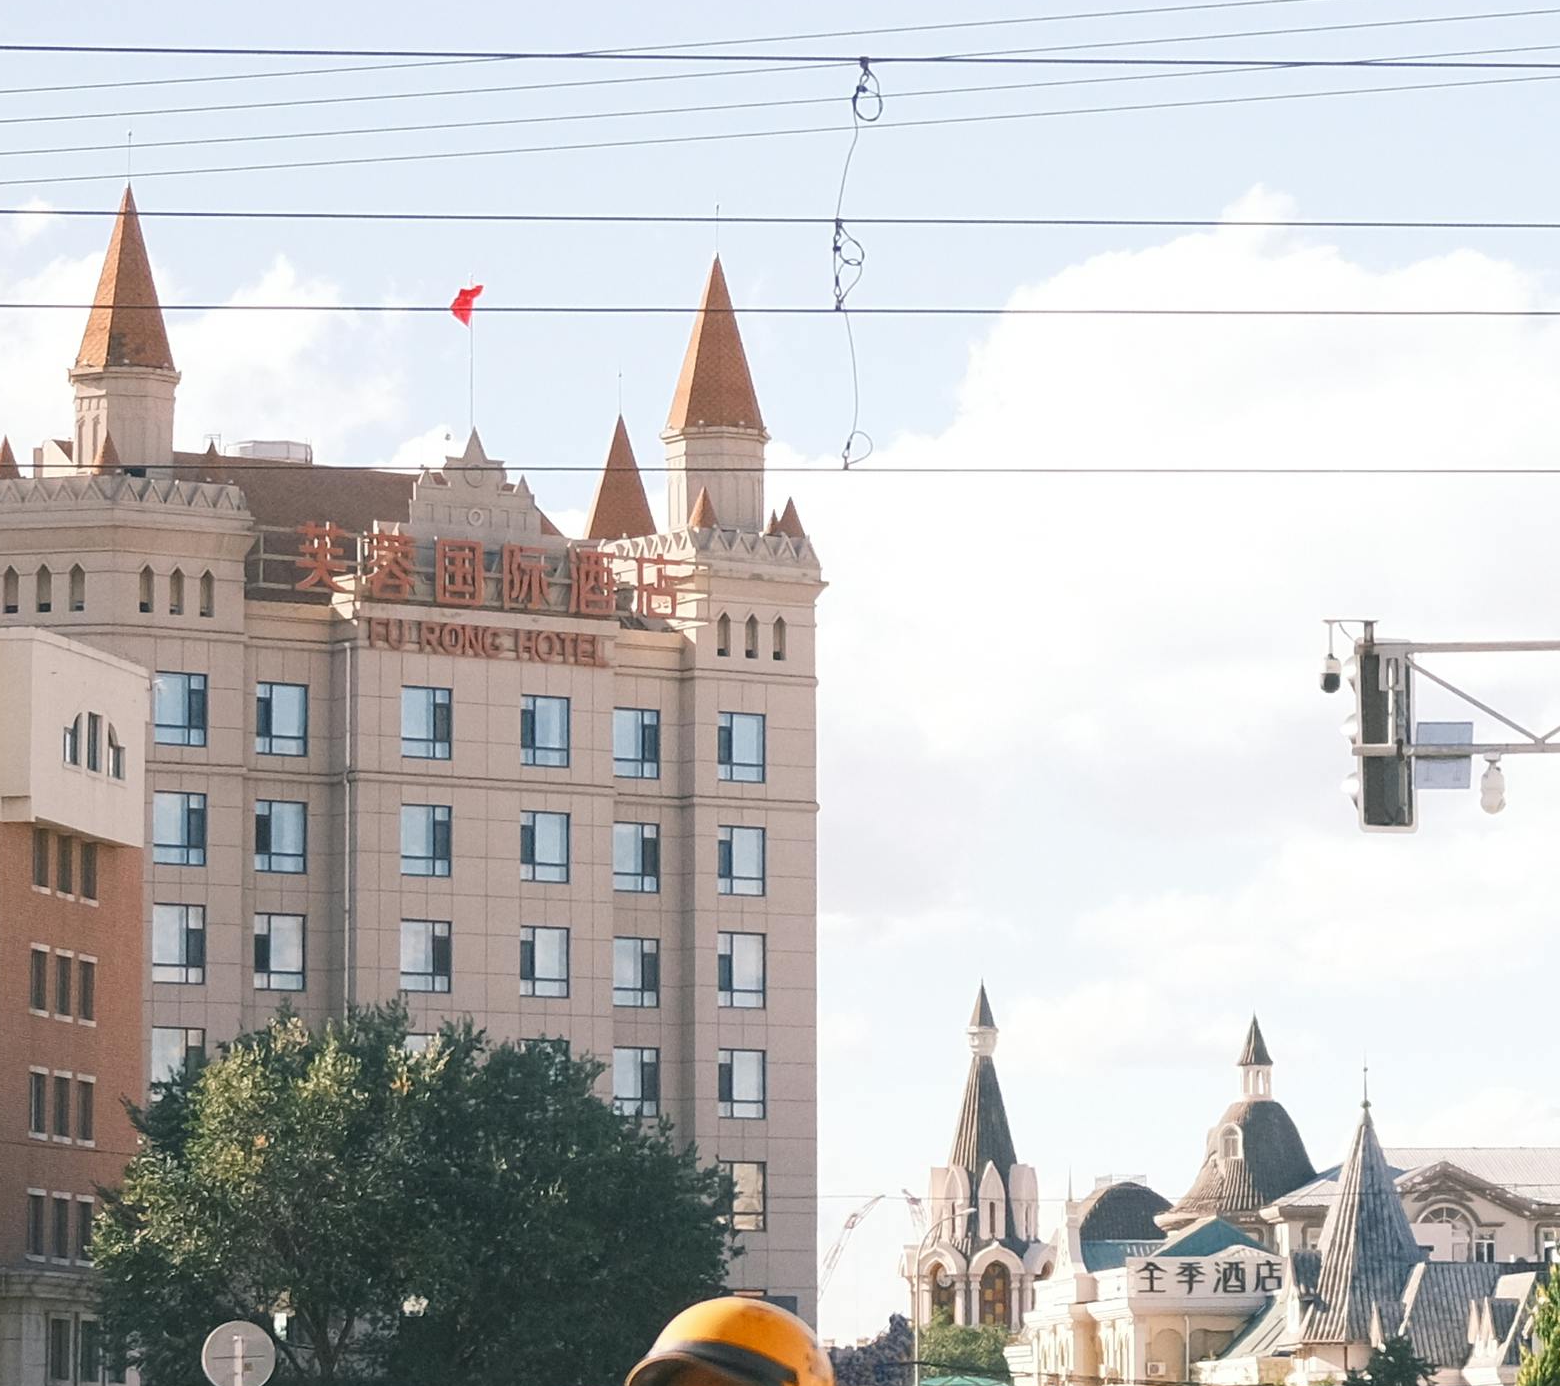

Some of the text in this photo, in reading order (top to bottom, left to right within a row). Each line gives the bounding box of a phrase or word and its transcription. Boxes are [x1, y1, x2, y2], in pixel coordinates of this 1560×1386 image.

[296, 521, 694, 619] 芙蓉国际酒店
[369, 617, 611, 668] FU RONG HOTEL
[1136, 1260, 1283, 1295] 全季酒店
